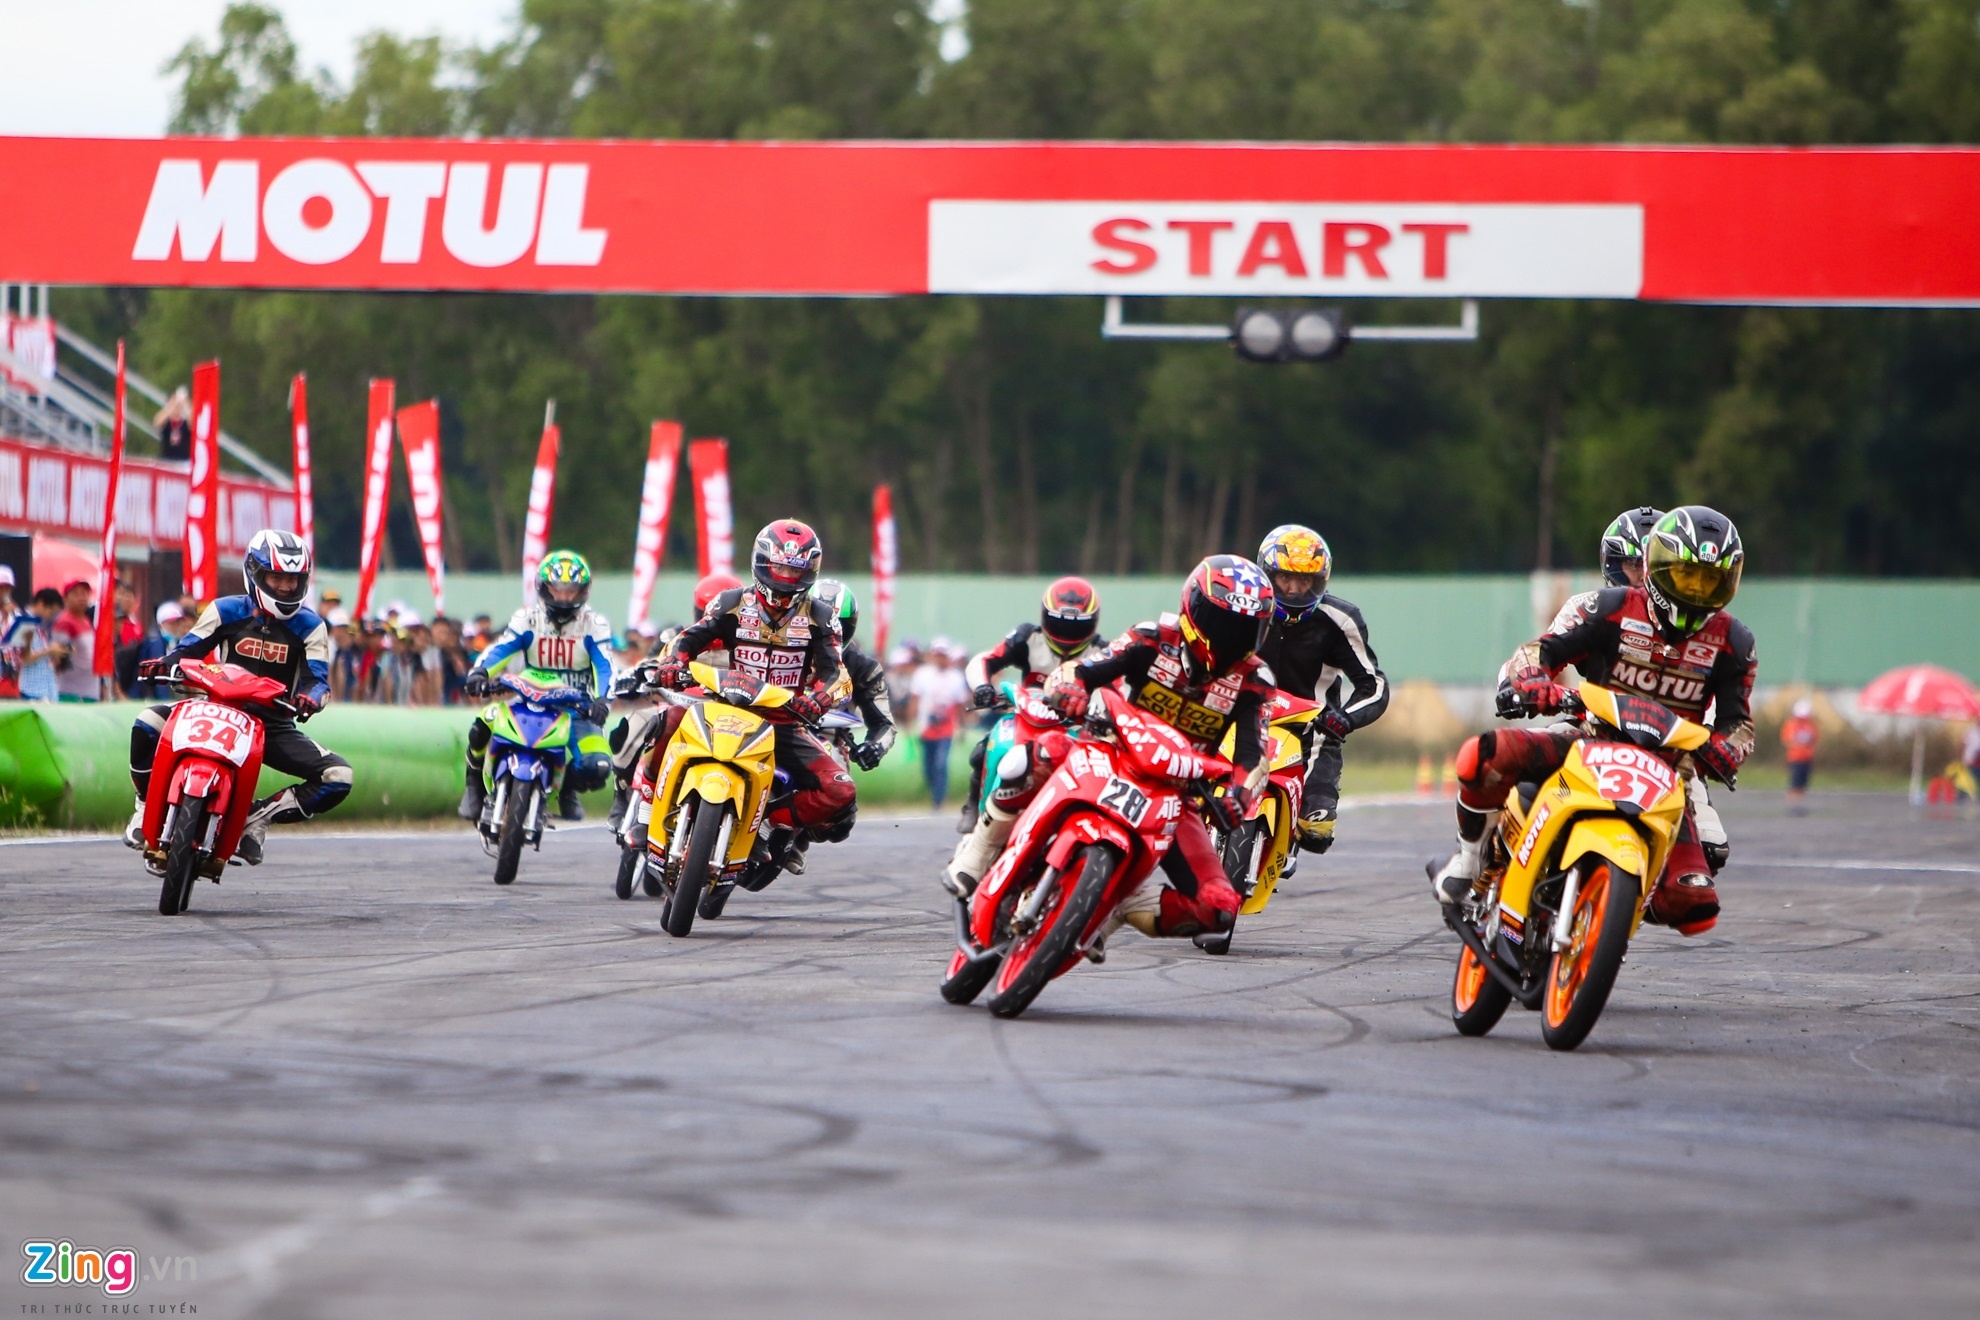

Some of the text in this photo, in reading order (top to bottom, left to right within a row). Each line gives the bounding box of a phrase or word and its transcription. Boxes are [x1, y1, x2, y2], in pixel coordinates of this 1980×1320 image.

[132, 158, 608, 267] MOTUL
[1090, 217, 1469, 280] START
[1228, 594, 1260, 608] KYT
[538, 638, 576, 668] FIAT
[736, 649, 801, 664] HONDA
[1612, 662, 1705, 701] MOTUL
[185, 704, 248, 733] MOTUL
[188, 719, 238, 755] 34
[1585, 746, 1673, 789] MOTUL
[1155, 795, 1182, 820] ATE
[1600, 769, 1661, 811] 37
[1517, 806, 1551, 866] MOTUL
